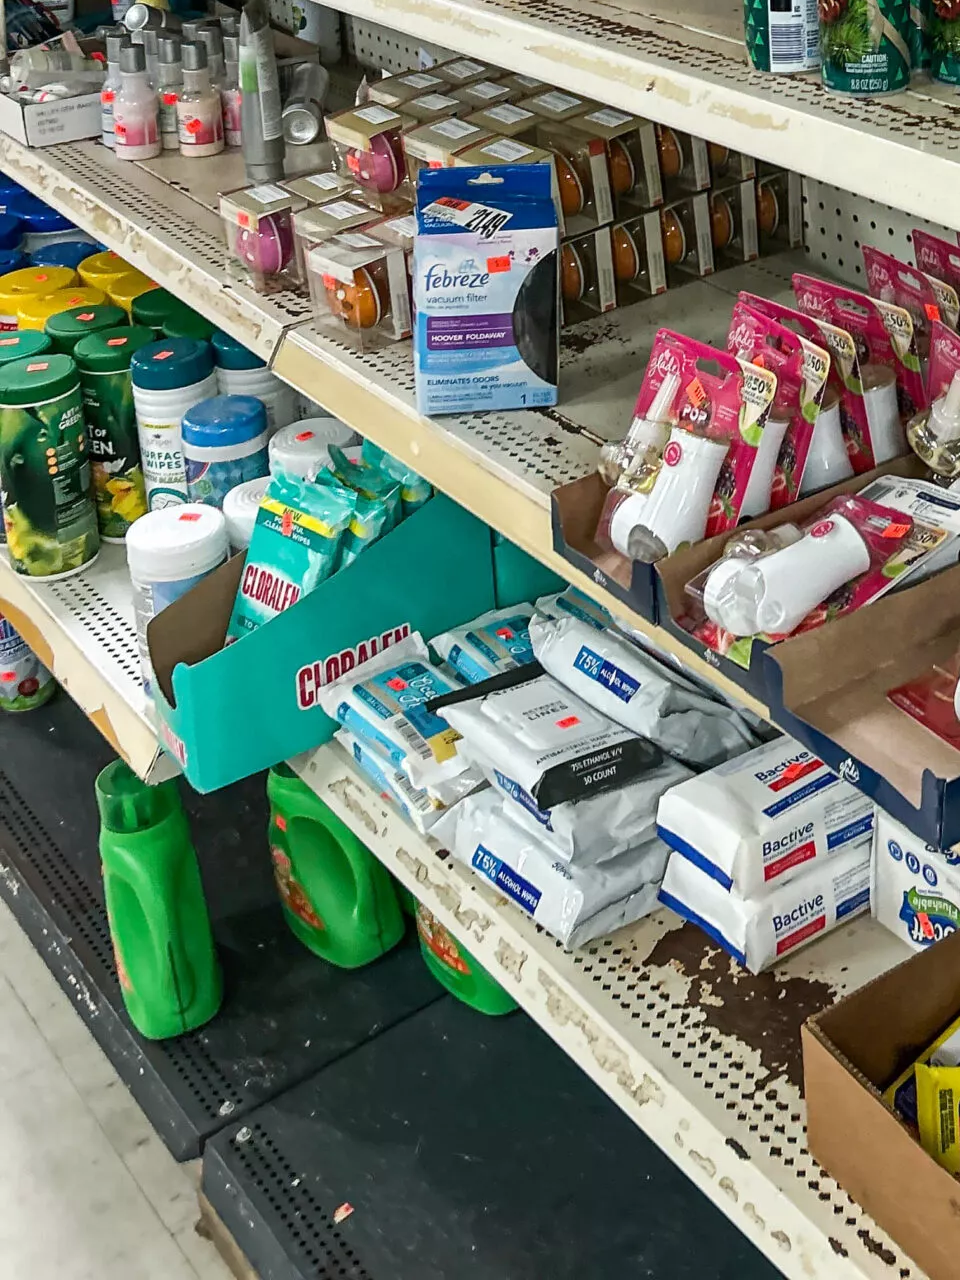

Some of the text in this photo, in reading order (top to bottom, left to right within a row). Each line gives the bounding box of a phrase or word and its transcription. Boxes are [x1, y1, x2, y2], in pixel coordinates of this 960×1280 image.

[424, 263, 489, 292] febreze
[427, 294, 488, 304] vacuum filter
[432, 332, 506, 342] HOOVER FOLDAWAY
[427, 375, 499, 386] ELIMINATES ODORS
[521, 394, 526, 405] 1
[682, 407, 707, 421] POP
[146, 461, 181, 469] WIPES
[578, 649, 599, 676] 75%
[583, 751, 610, 766] ETHANOL
[583, 766, 617, 785] 30 COUNT
[762, 821, 814, 857] Bactive
[843, 825, 865, 840] CAUTION
[475, 849, 539, 909] 75% ALCOHOL WIPES
[772, 893, 824, 932] Bactive
[911, 896, 959, 920] Flushable
